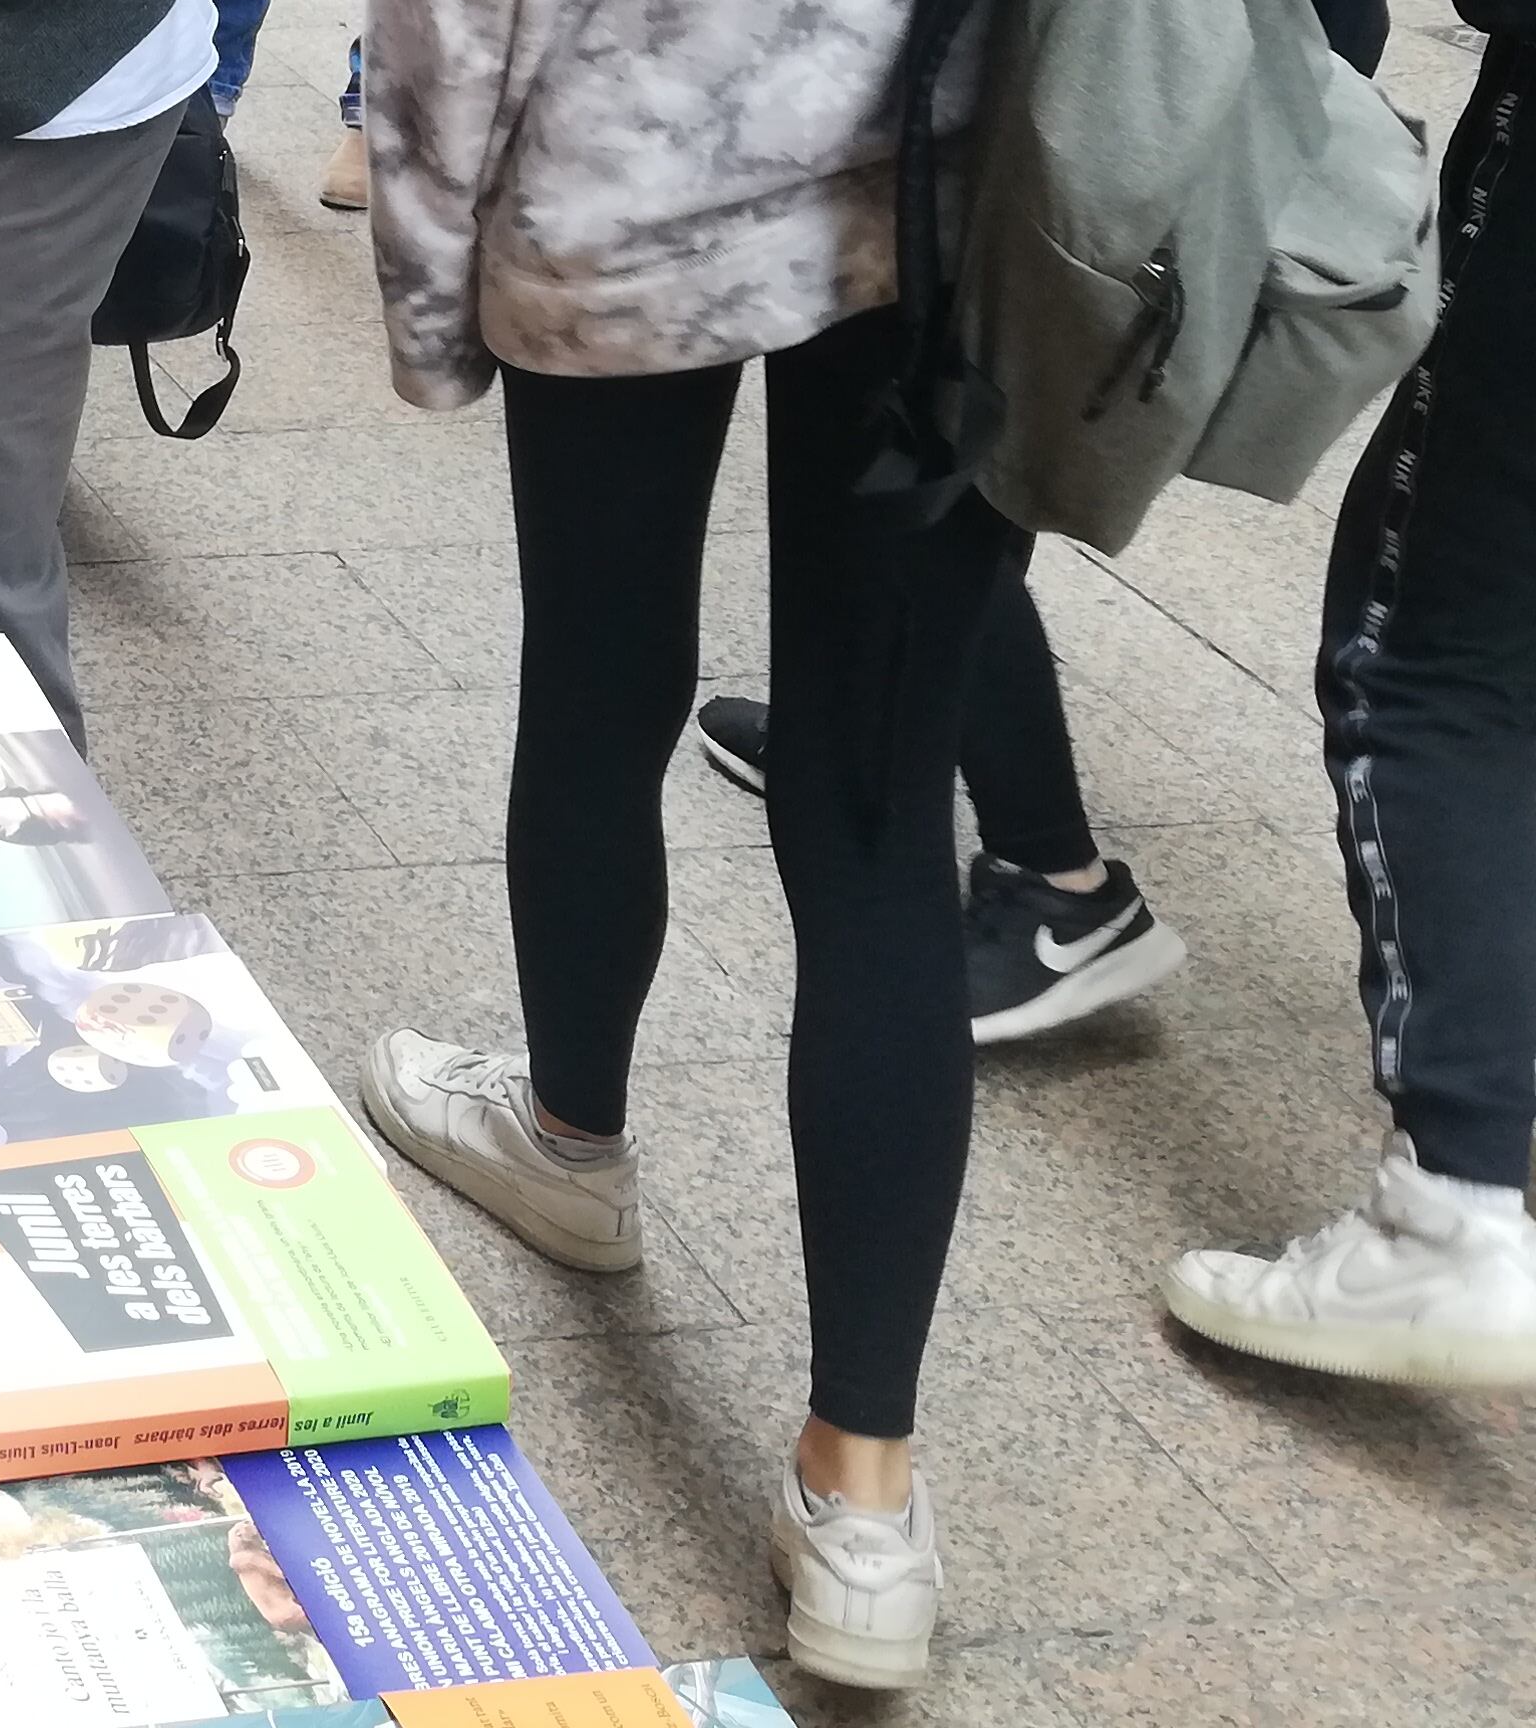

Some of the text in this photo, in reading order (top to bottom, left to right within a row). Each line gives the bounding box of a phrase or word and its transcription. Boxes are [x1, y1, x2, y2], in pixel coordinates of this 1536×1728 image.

[54, 1174, 161, 1321] a les terres
[96, 1164, 212, 1325] dels bàrbars
[41, 1436, 120, 1457] Joan-Lluís
[134, 1426, 194, 1444] bàrbars
[199, 1422, 233, 1439] dels
[238, 1416, 285, 1433] terres
[294, 1410, 374, 1432] Junil les
[278, 1448, 408, 1649] ANAGRAMA DE 2019
[302, 1448, 449, 1676] UNION PRIZE FOR LITERATURE 2020
[338, 1469, 475, 1676] MARIA ANGLADA 2020
[389, 1510, 501, 1675] PUNT DE LLIBRE 2019 DE
[391, 1474, 477, 1595] OTRA MIRADA 2019
[307, 1556, 378, 1647] 15a edició
